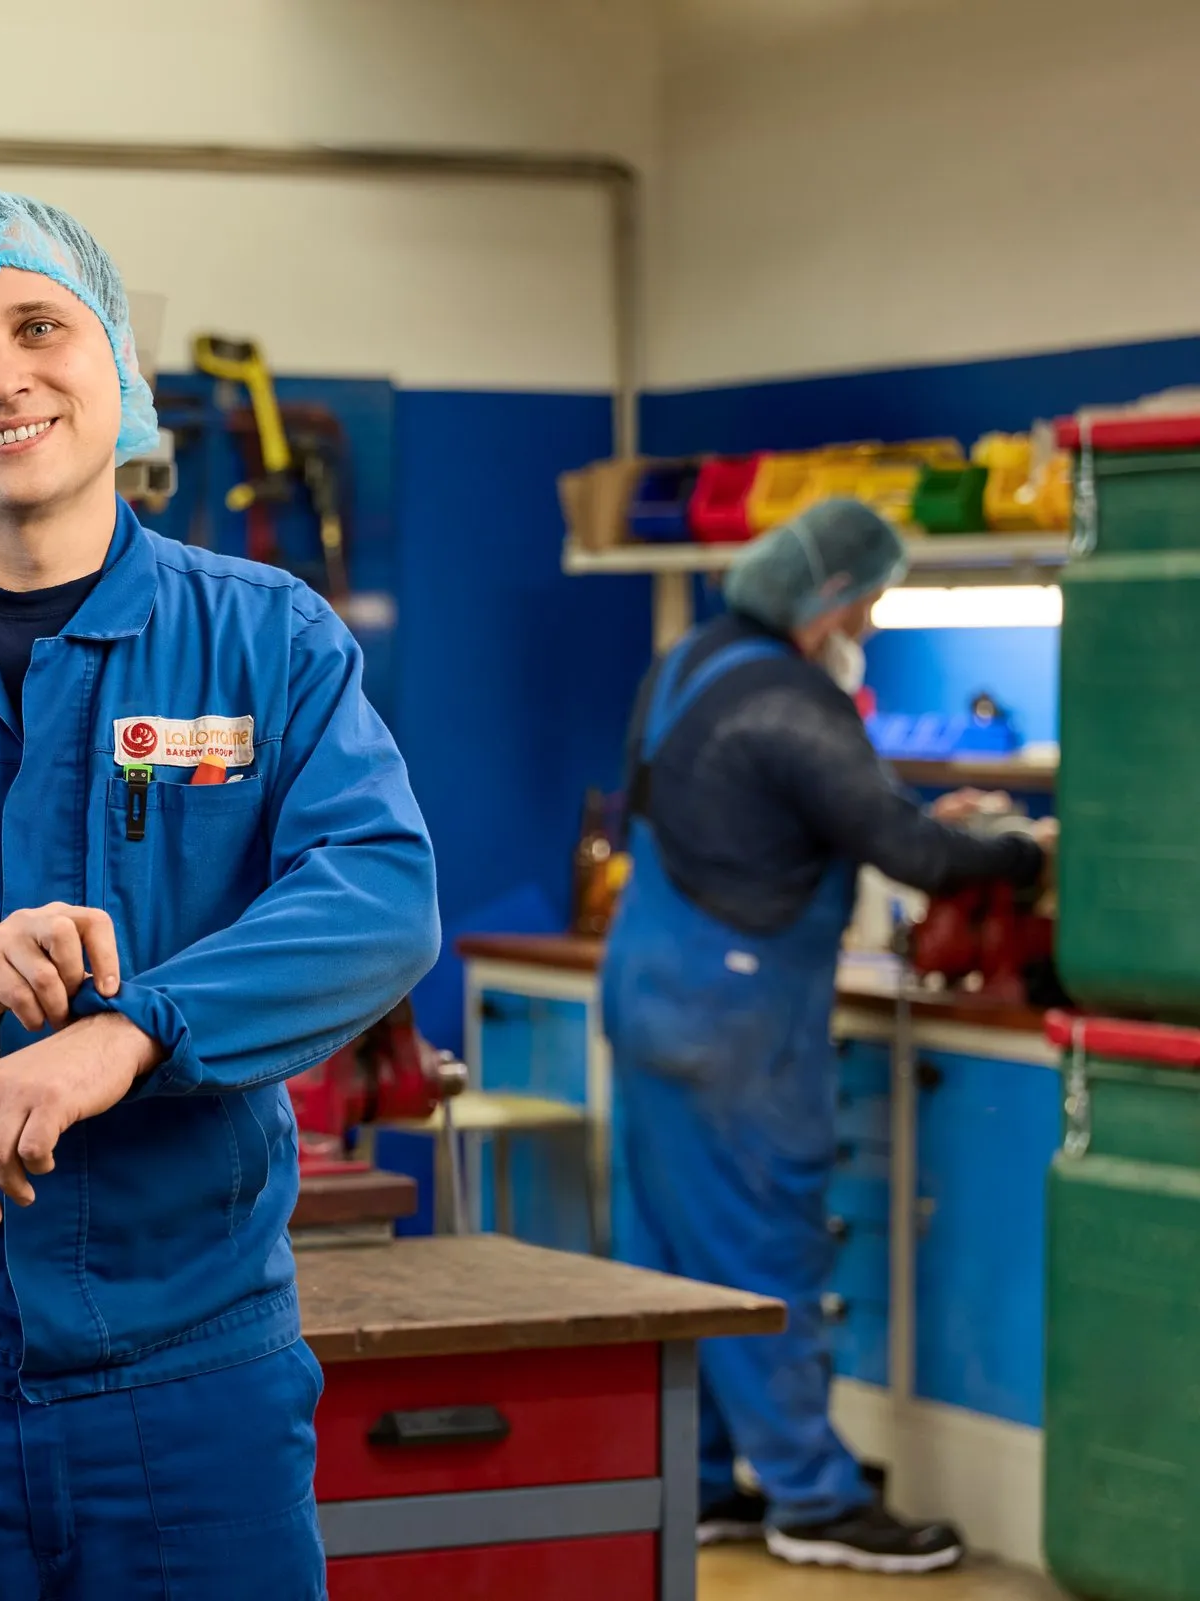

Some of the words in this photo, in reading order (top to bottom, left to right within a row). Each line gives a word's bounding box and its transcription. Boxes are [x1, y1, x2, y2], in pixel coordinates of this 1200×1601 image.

[164, 729, 187, 745] La
[189, 728, 249, 746] Lorraine
[165, 748, 203, 758] BAKERY
[207, 747, 233, 757] GROUP
